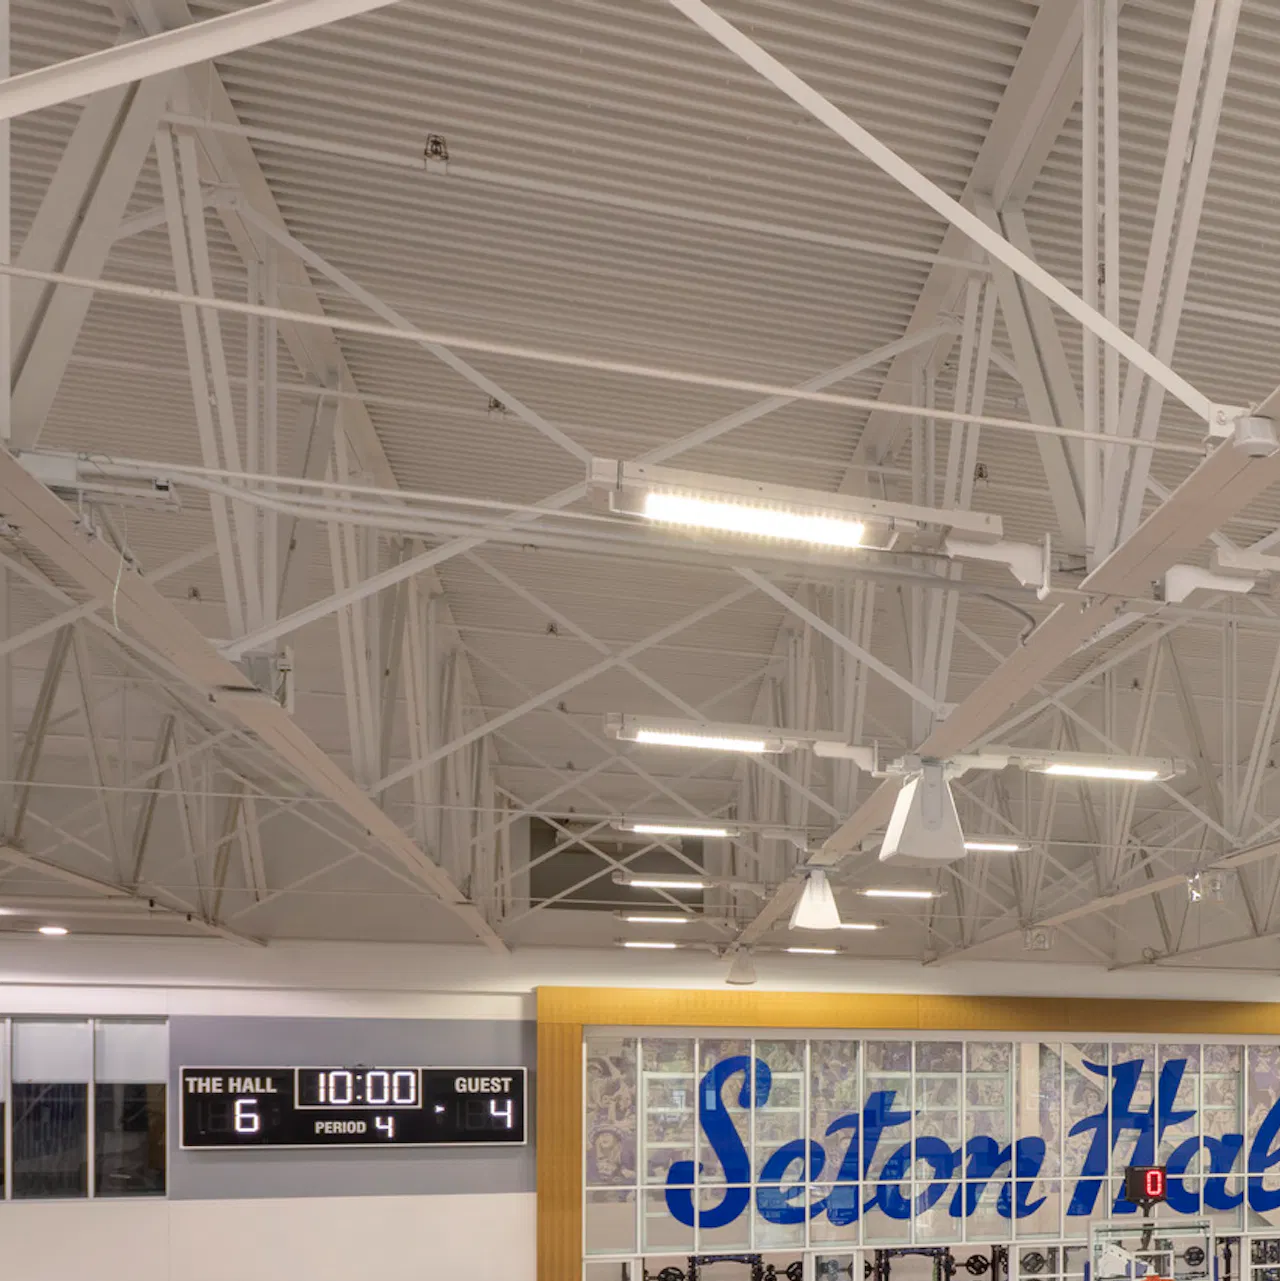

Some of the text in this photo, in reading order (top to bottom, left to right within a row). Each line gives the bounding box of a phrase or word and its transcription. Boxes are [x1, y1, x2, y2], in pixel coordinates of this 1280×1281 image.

[185, 1077, 277, 1094] THE HALL
[318, 1070, 416, 1104] 10:00
[455, 1077, 513, 1094] GUEST
[234, 1098, 260, 1133] 6
[315, 1116, 394, 1138] PERIOD 4
[490, 1099, 513, 1129] 4
[665, 1055, 1048, 1229] Seton
[1145, 1170, 1163, 1196] 0
